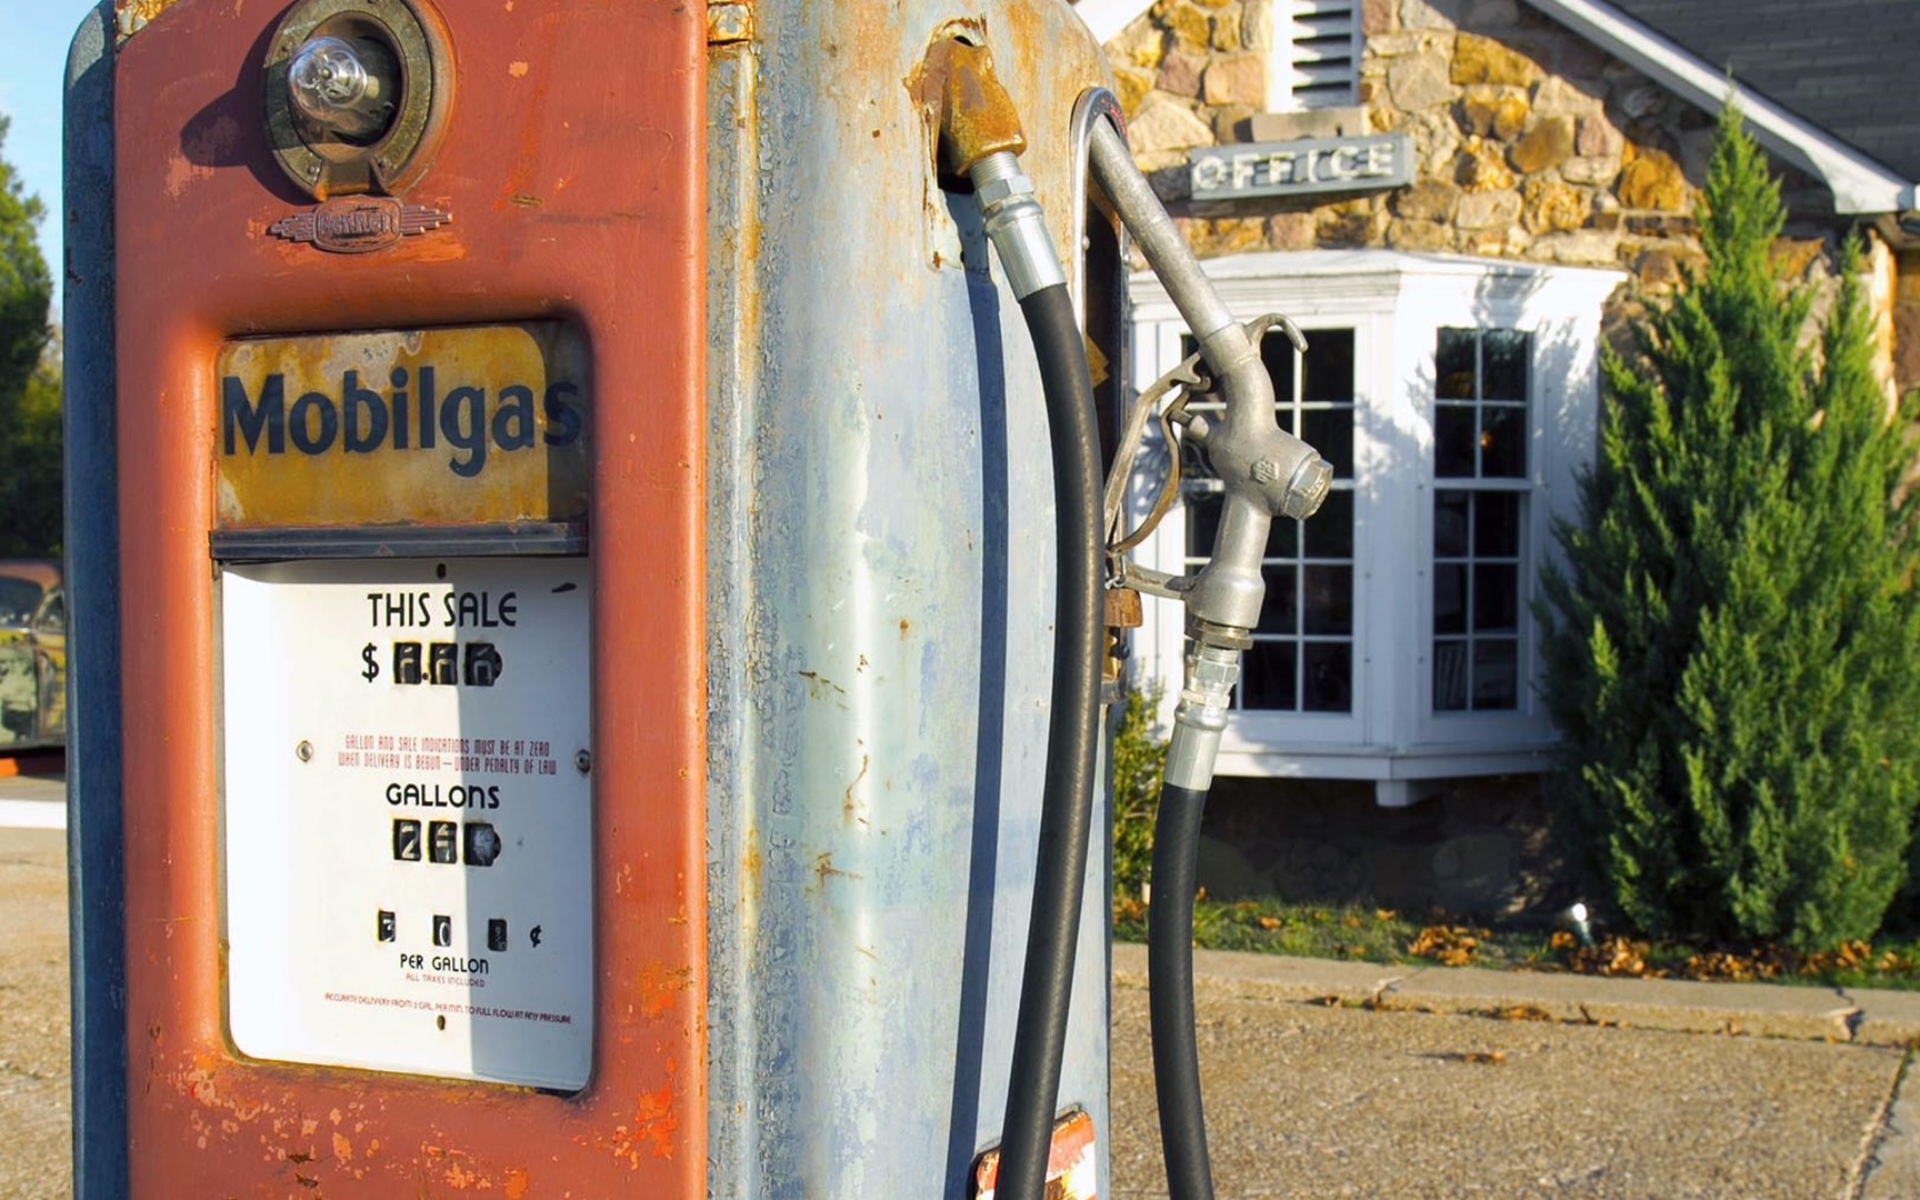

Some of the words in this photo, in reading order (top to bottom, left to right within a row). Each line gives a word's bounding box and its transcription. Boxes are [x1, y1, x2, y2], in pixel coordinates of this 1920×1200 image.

[1194, 143, 1394, 190] OFFICE
[222, 366, 582, 477] Mobilgas
[367, 592, 431, 627] THIS
[443, 591, 517, 627] SALE
[361, 642, 379, 683] $
[345, 734, 374, 750] GALLON
[378, 735, 394, 750] AND
[398, 736, 418, 752] SALE
[421, 736, 470, 754] INDICATIONS
[474, 739, 495, 755] MUST
[500, 740, 510, 755] BE
[514, 740, 524, 756] AT
[529, 741, 550, 757] ZERO
[338, 752, 360, 766] WHEN
[364, 753, 400, 768] DELIVERY
[404, 754, 412, 769] IS
[454, 757, 480, 772] UNDER
[484, 758, 519, 774] PENALTY
[524, 759, 534, 774] OF
[538, 760, 557, 775] LAW
[386, 783, 500, 809] GALLONS
[400, 953, 424, 969] PER
[432, 956, 489, 974] GALLON
[406, 973, 420, 982] ALL
[422, 974, 446, 984] TAXES
[448, 977, 486, 988] INCLUDED
[465, 1005, 475, 1015] TO
[476, 1007, 492, 1016] FULL
[492, 1008, 514, 1018] FLOW
[539, 1013, 572, 1024] PRESSURE
